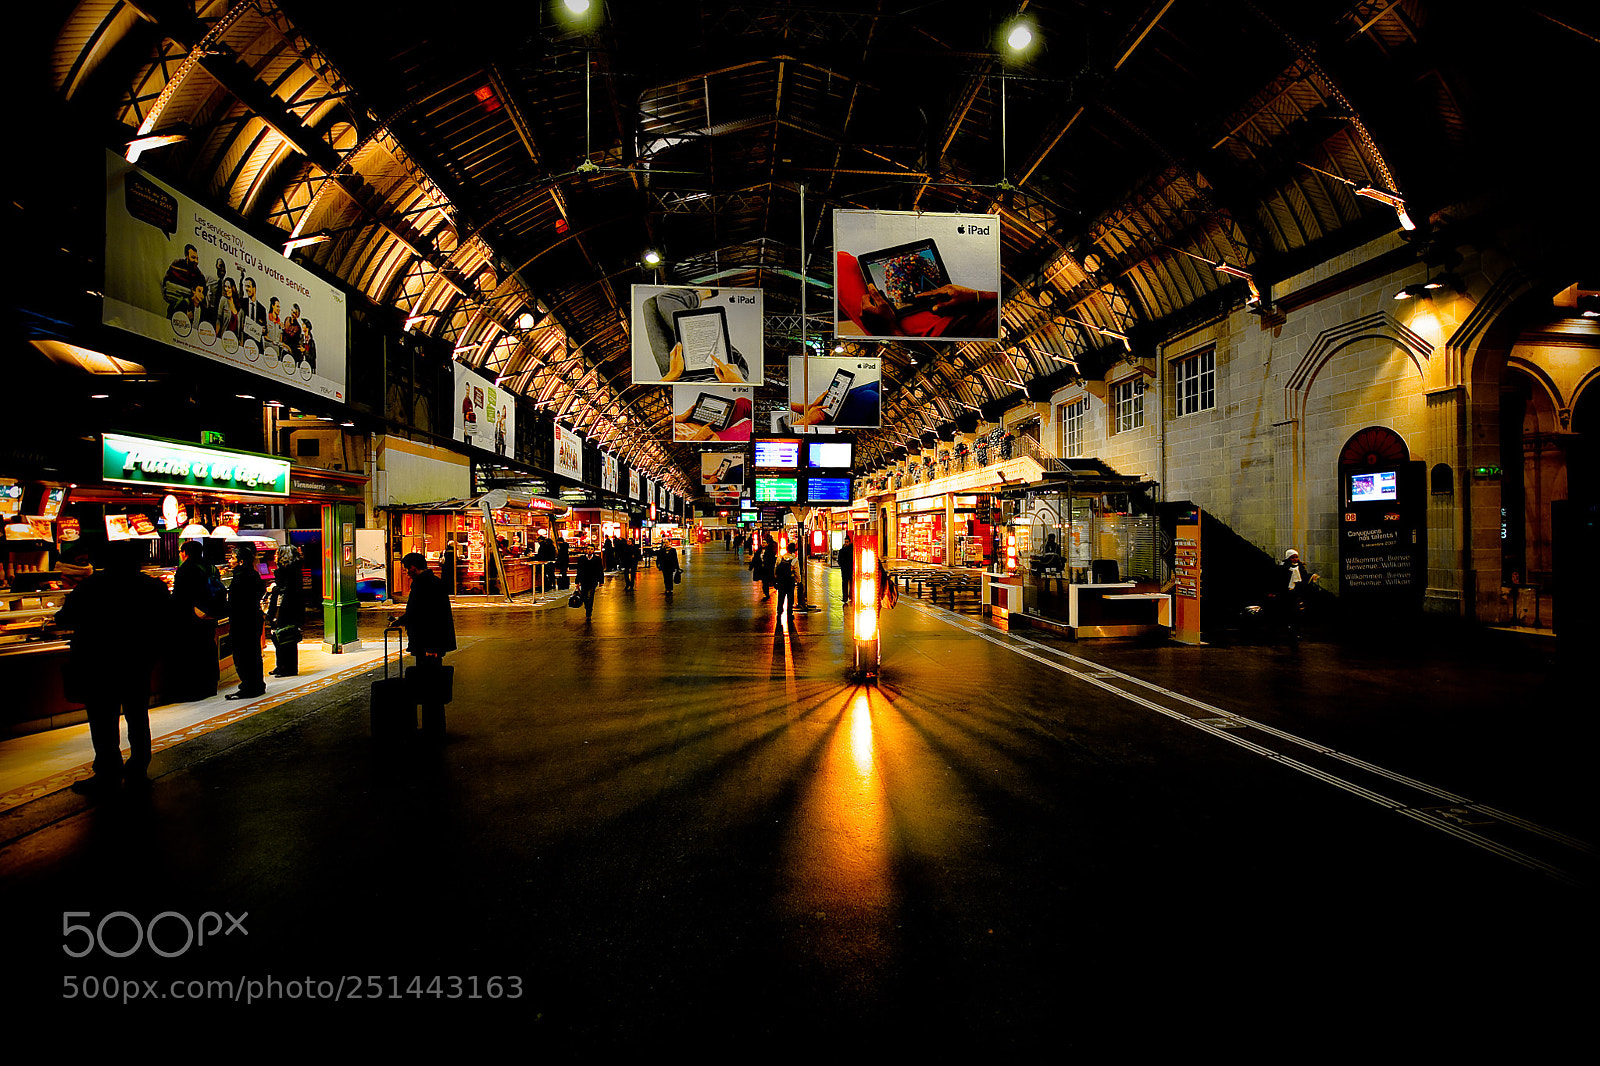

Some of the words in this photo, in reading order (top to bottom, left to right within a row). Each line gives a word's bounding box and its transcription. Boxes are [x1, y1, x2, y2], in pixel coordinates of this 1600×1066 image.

[194, 212, 206, 227] Les
[206, 222, 231, 240] services
[967, 224, 990, 236] iPad
[194, 225, 217, 247] c'est
[219, 238, 238, 258] tout
[239, 248, 257, 267] TGV
[257, 259, 263, 271] à
[264, 265, 285, 284] votre
[285, 277, 312, 299] service.
[737, 295, 756, 305] iPad
[862, 362, 876, 370] iPad
[210, 461, 233, 481] la
[293, 479, 328, 491] Viennoiserie
[1345, 513, 1356, 521] DB
